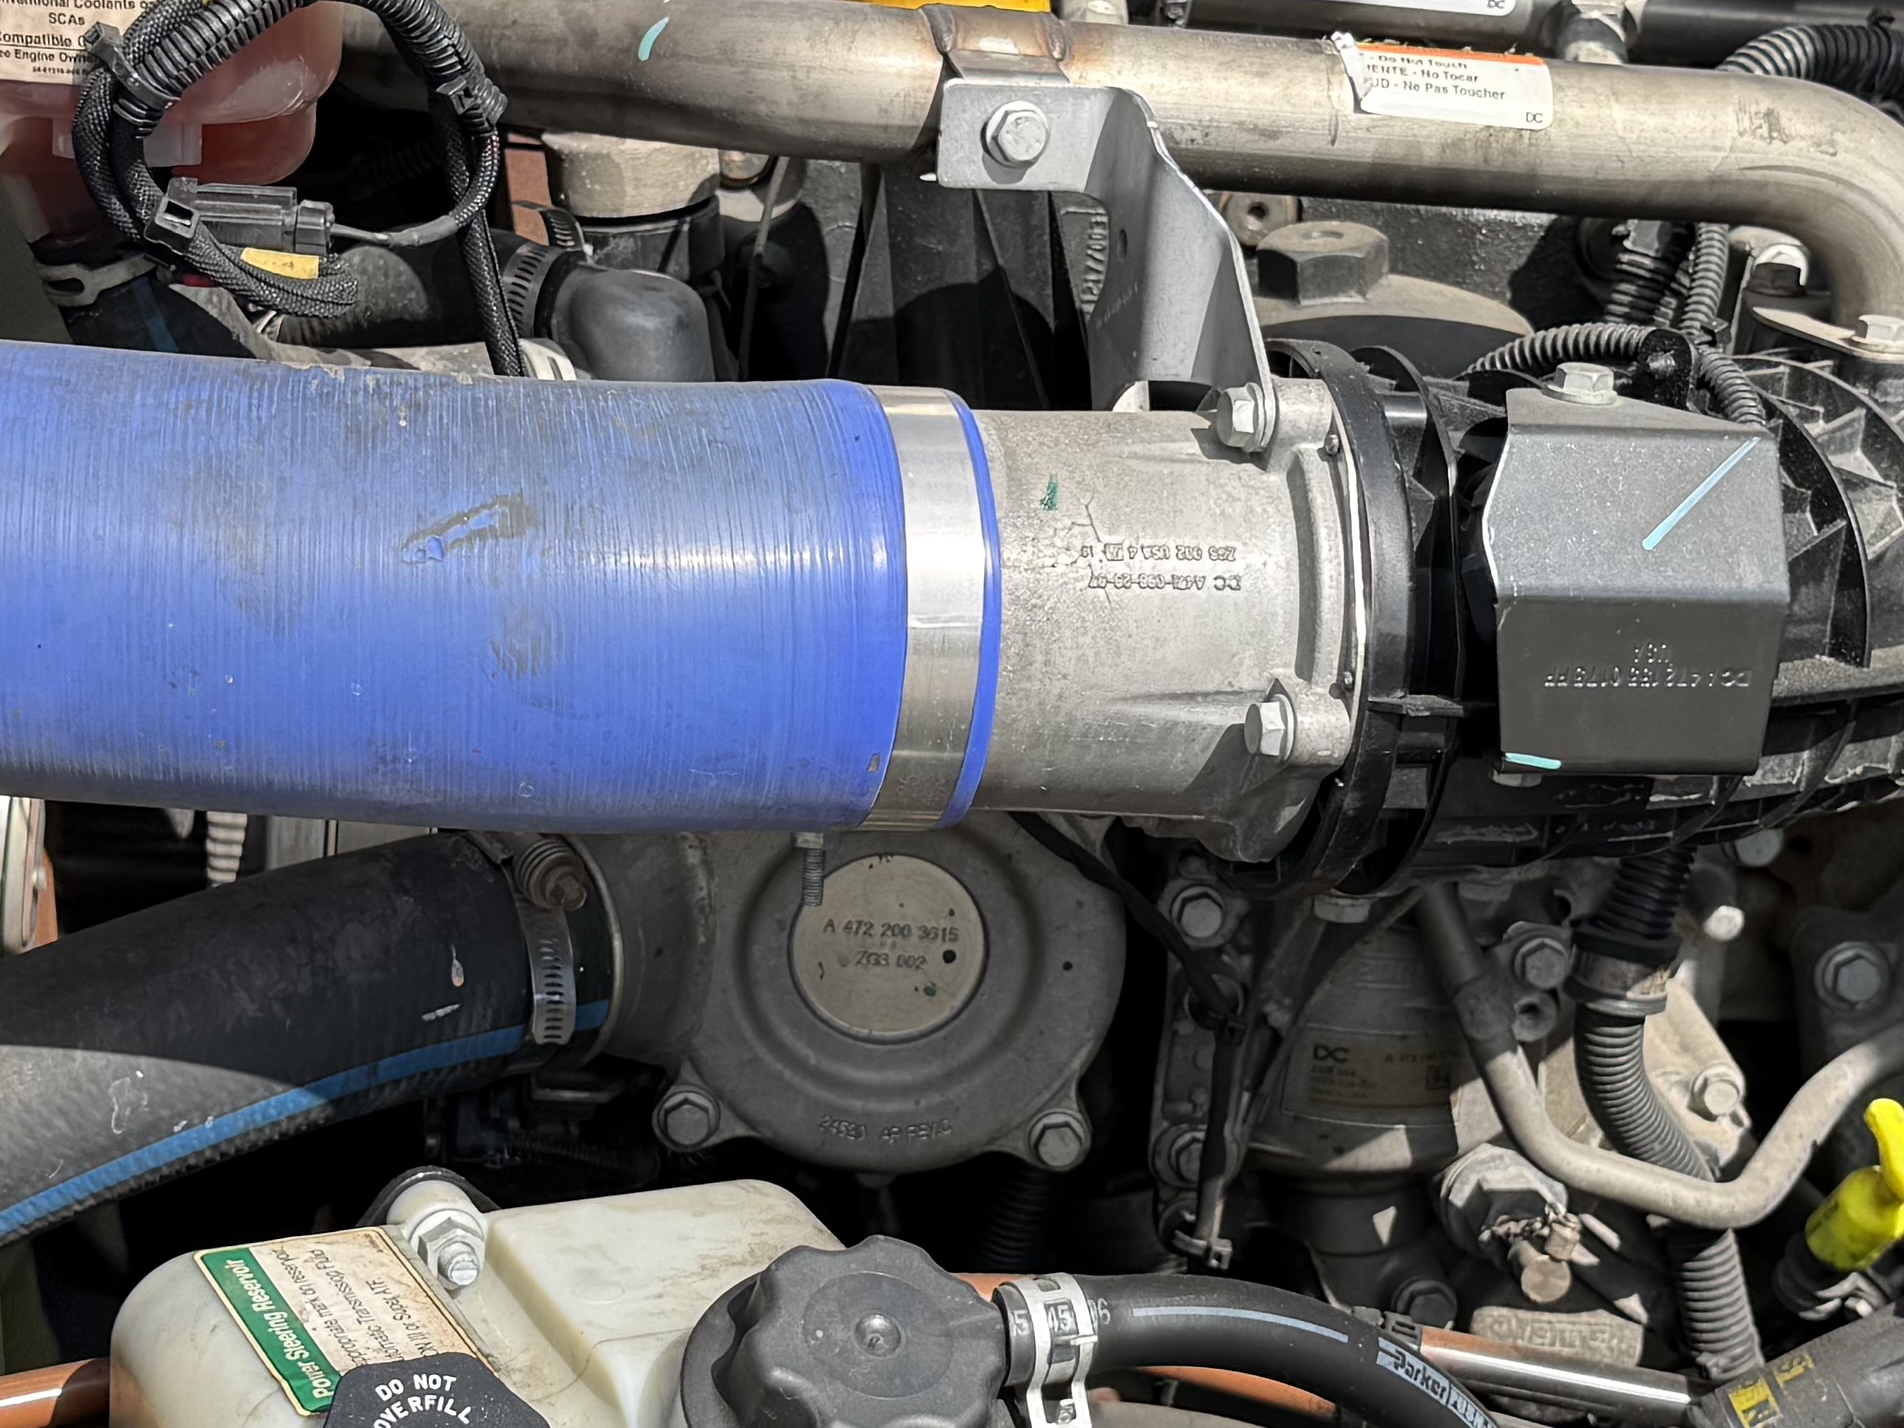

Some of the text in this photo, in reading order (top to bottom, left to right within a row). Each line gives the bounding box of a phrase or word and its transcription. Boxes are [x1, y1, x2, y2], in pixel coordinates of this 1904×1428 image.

[48, 12, 86, 27] SCAs
[14, 47, 55, 63] Engine
[1421, 70, 1441, 81] No
[1402, 80, 1421, 92] No
[1424, 82, 1450, 97] Pas
[1452, 84, 1506, 102] Toucher
[1525, 111, 1544, 124] DC
[823, 918, 837, 935] A
[842, 921, 875, 936] 472
[880, 922, 912, 939] 200
[855, 950, 928, 970] ZGS 002
[1312, 1043, 1351, 1064] DC
[226, 1257, 337, 1400] Power Steering Reservoir
[365, 1323, 405, 1362] utomatic
[374, 1372, 458, 1403] DO NOT
[1393, 1352, 1448, 1405] Parker
